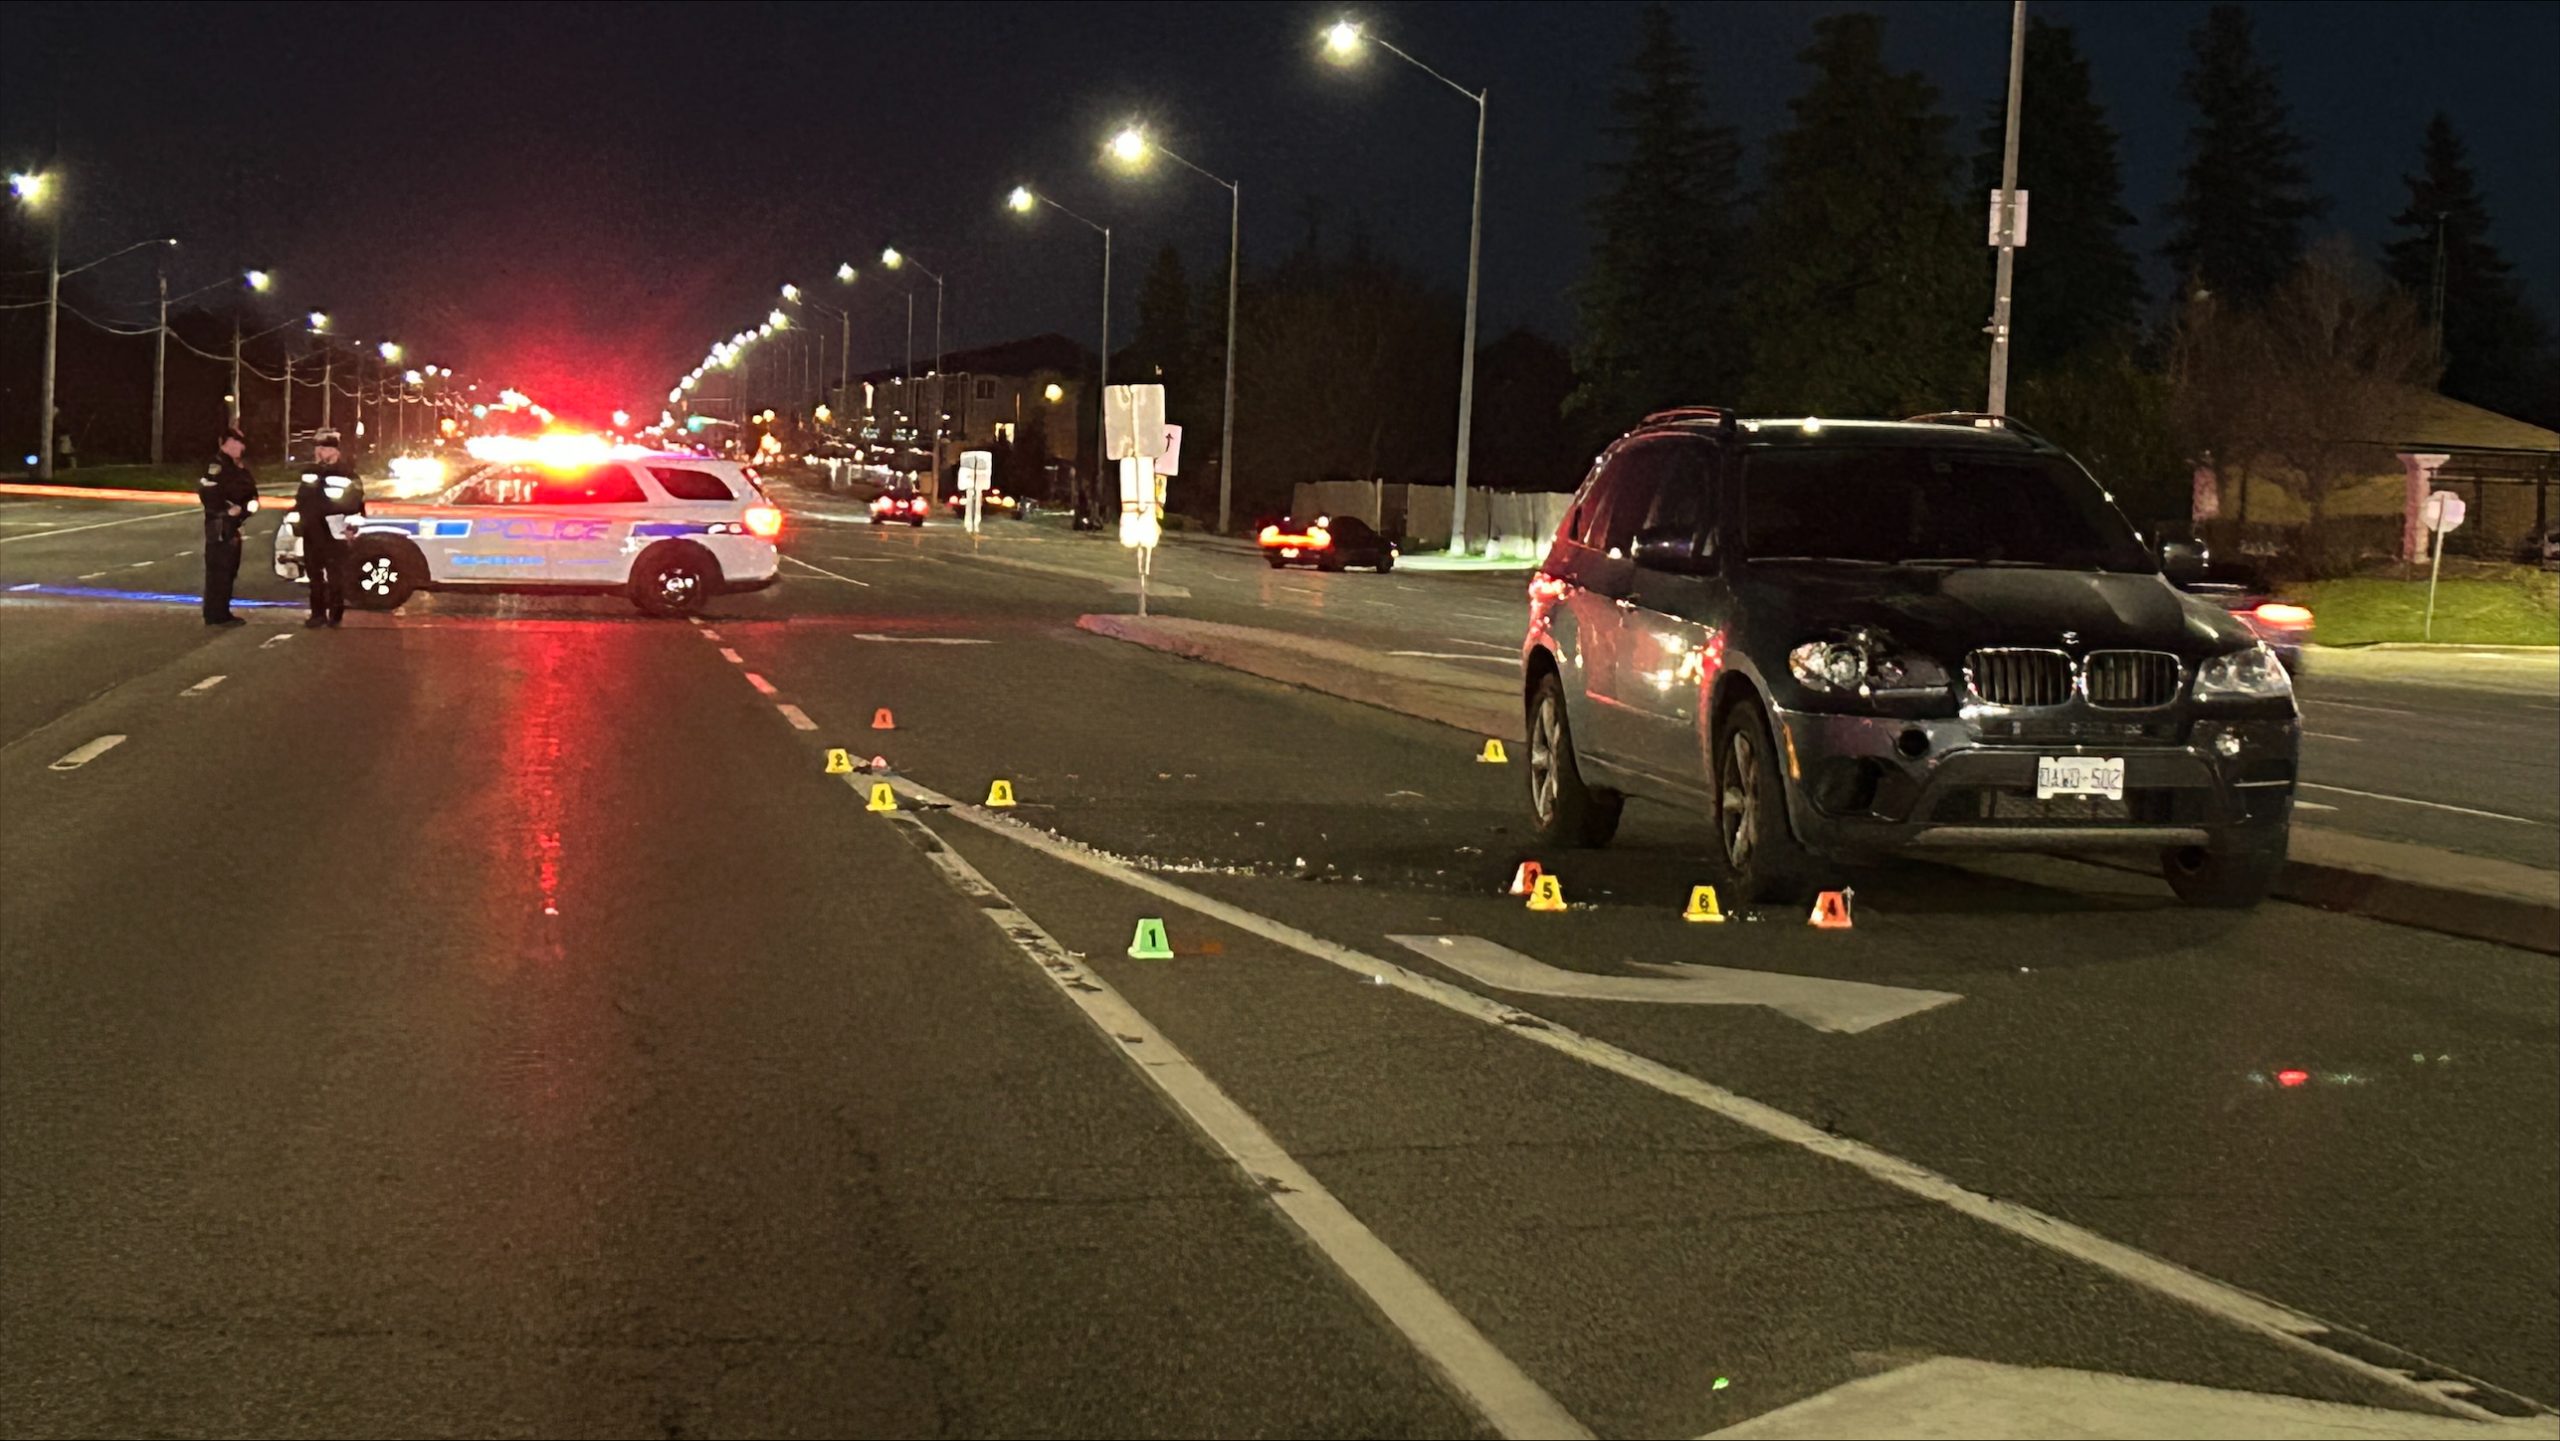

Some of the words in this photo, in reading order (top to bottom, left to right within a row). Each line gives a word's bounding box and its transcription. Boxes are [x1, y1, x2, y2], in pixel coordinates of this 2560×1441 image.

[478, 519, 612, 541] POLICE
[834, 753, 843, 767] 2
[1543, 881, 1553, 900] 5
[1699, 893, 1709, 912] 6
[1149, 928, 1156, 948] 1
